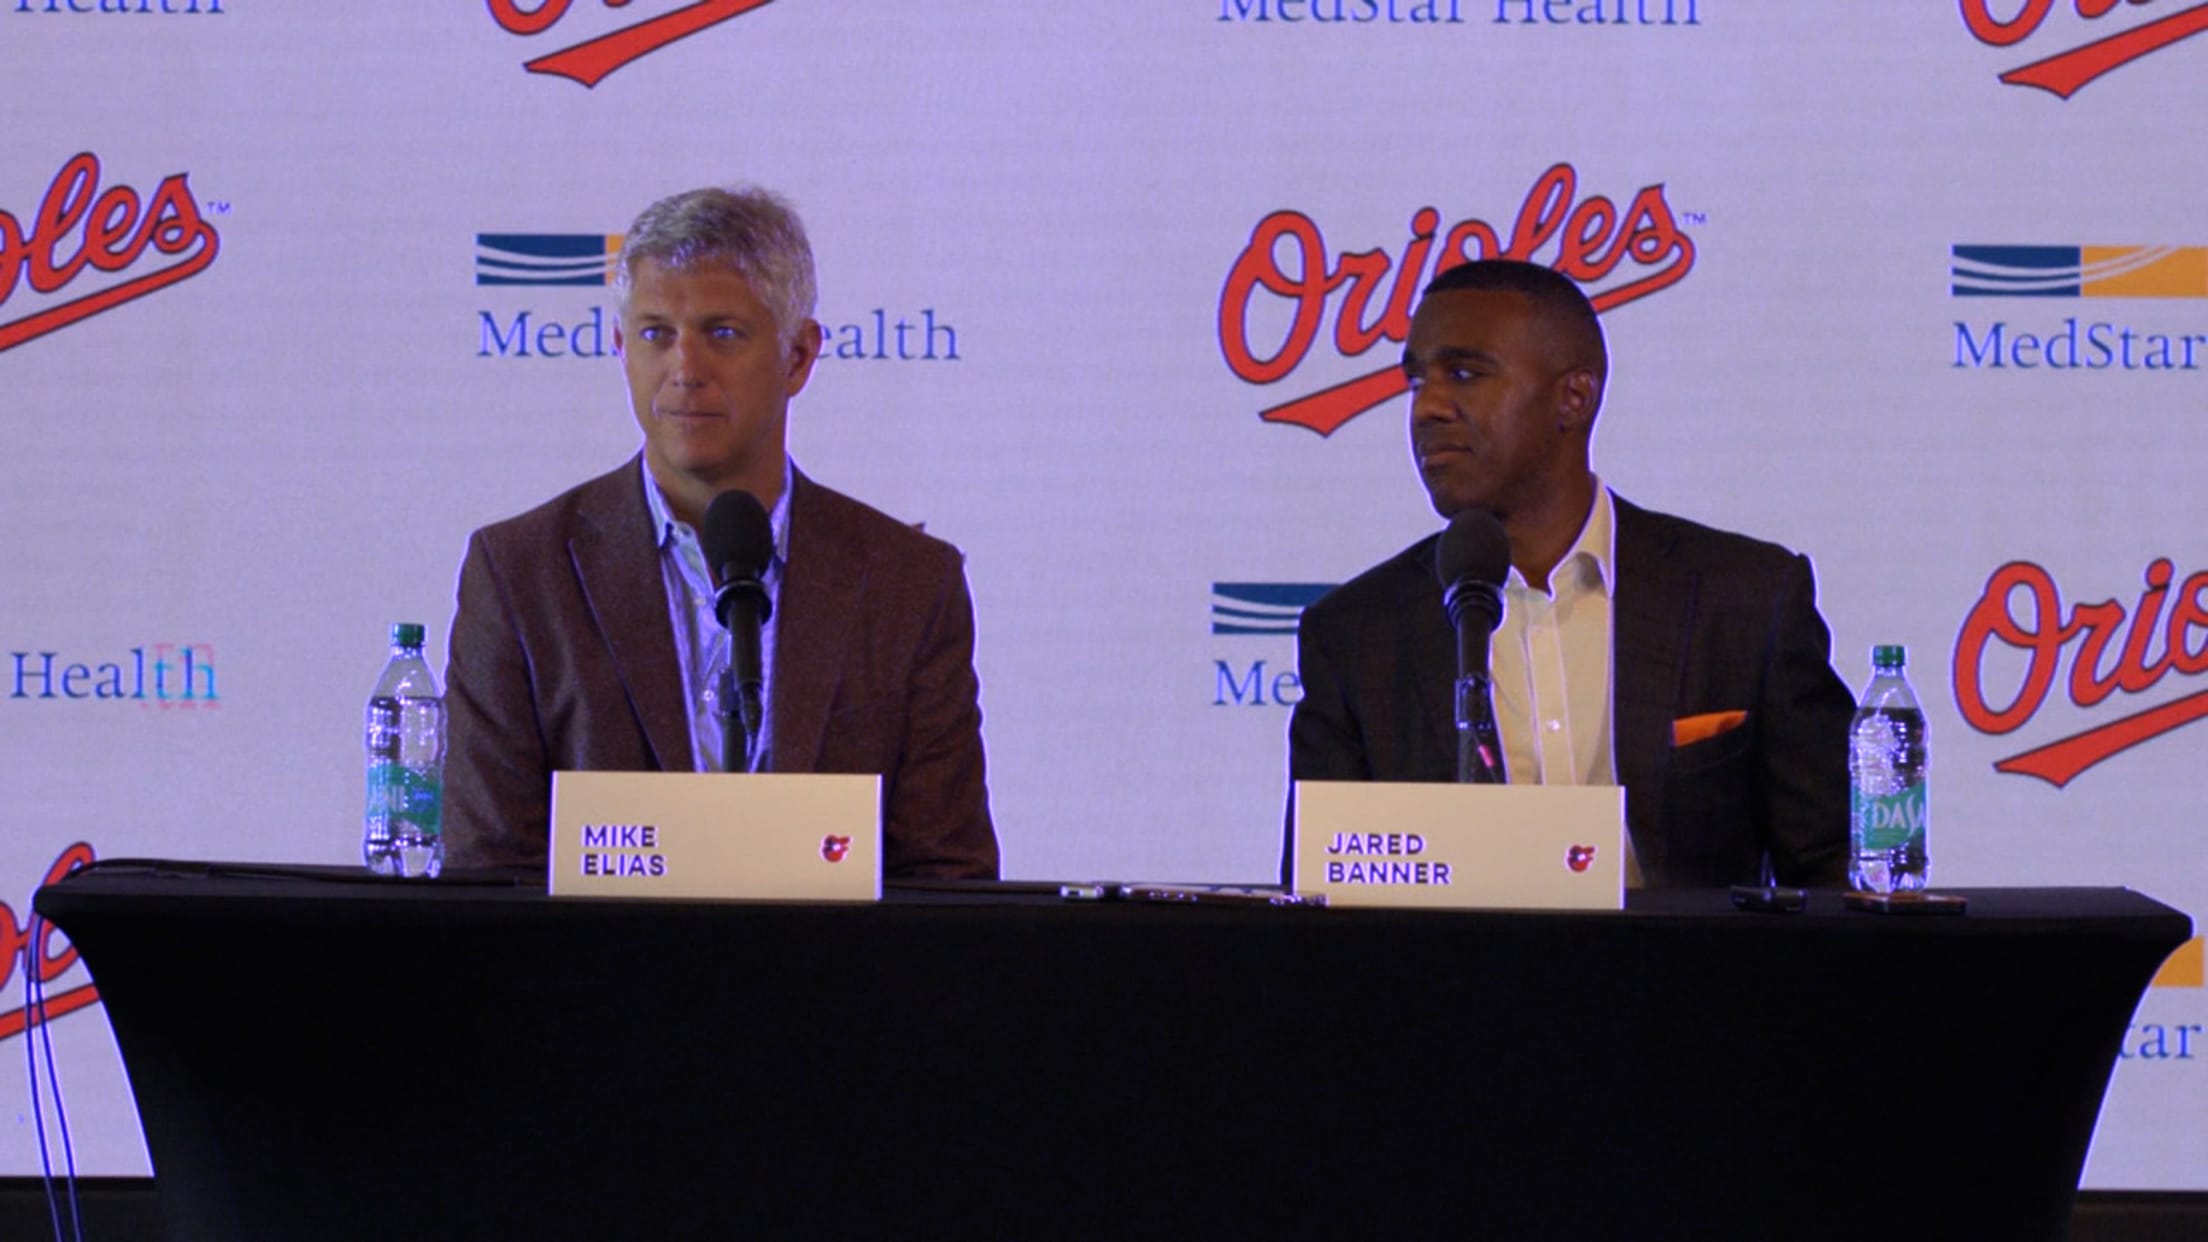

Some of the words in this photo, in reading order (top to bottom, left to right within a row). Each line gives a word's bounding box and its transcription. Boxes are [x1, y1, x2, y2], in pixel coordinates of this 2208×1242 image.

[476, 304, 617, 360] Med
[1951, 316, 2208, 371] MedStar
[10, 646, 221, 702] Health
[583, 824, 657, 849] MIKE
[1327, 832, 1424, 856] JARED
[583, 852, 666, 878] ELIAS
[1327, 860, 1451, 885] BANNER
